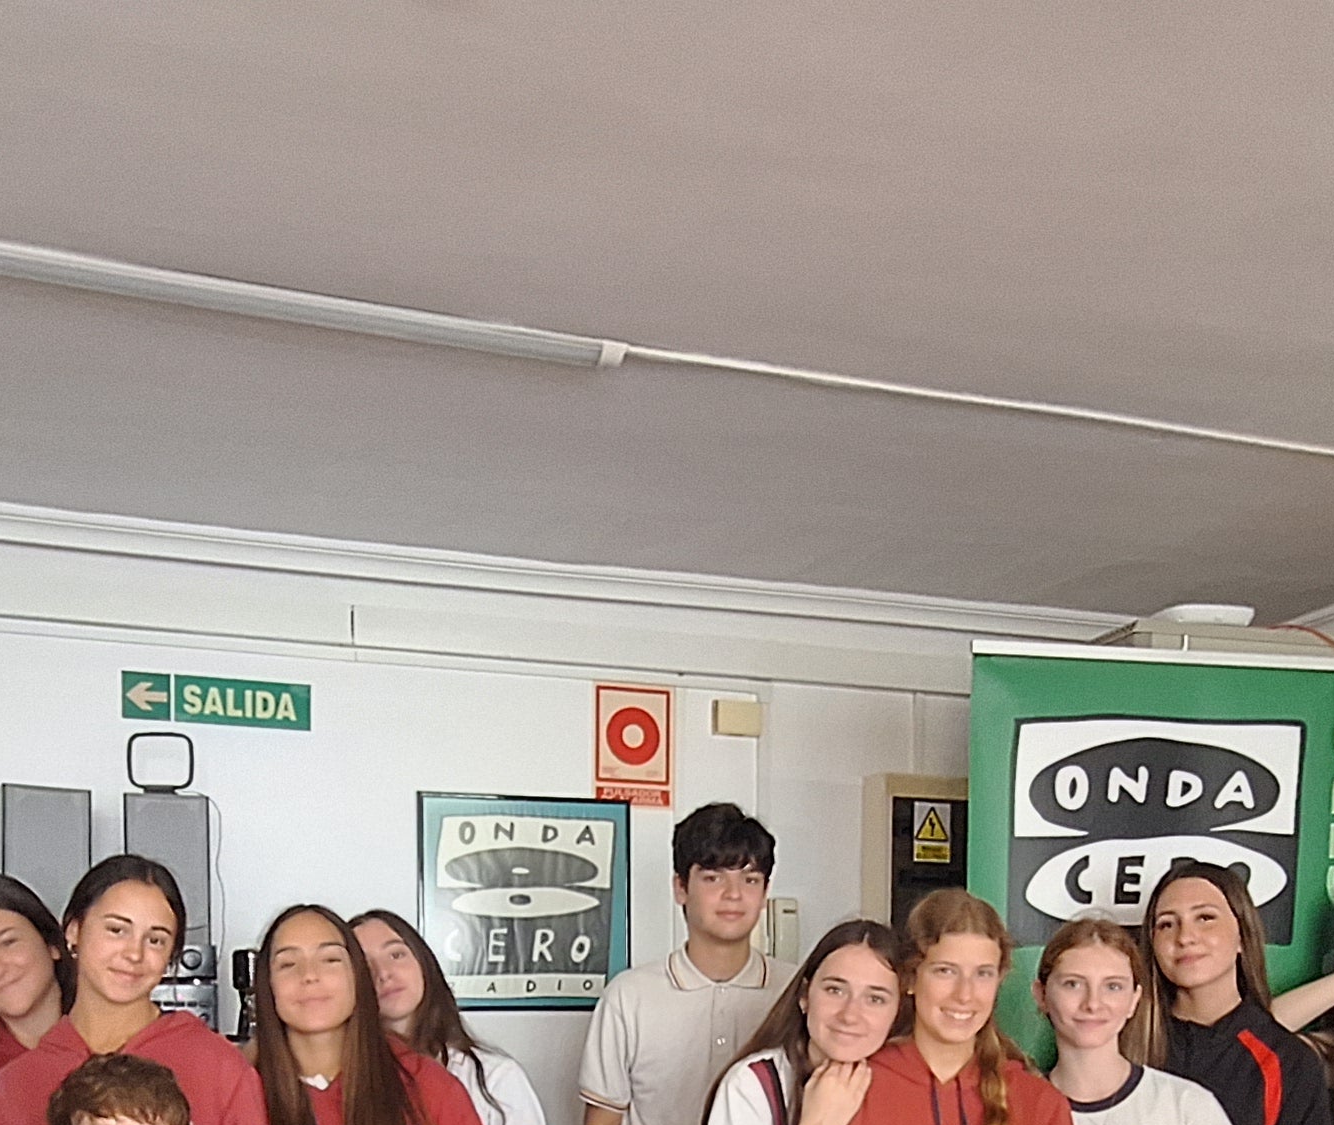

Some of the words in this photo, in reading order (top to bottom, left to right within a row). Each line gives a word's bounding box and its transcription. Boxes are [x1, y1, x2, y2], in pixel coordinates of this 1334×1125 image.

[183, 684, 298, 722] SALIDA
[1054, 764, 1255, 811] ONDA
[458, 820, 596, 846] ONDA
[1064, 854, 1251, 905] CE
[445, 927, 592, 964] CERO
